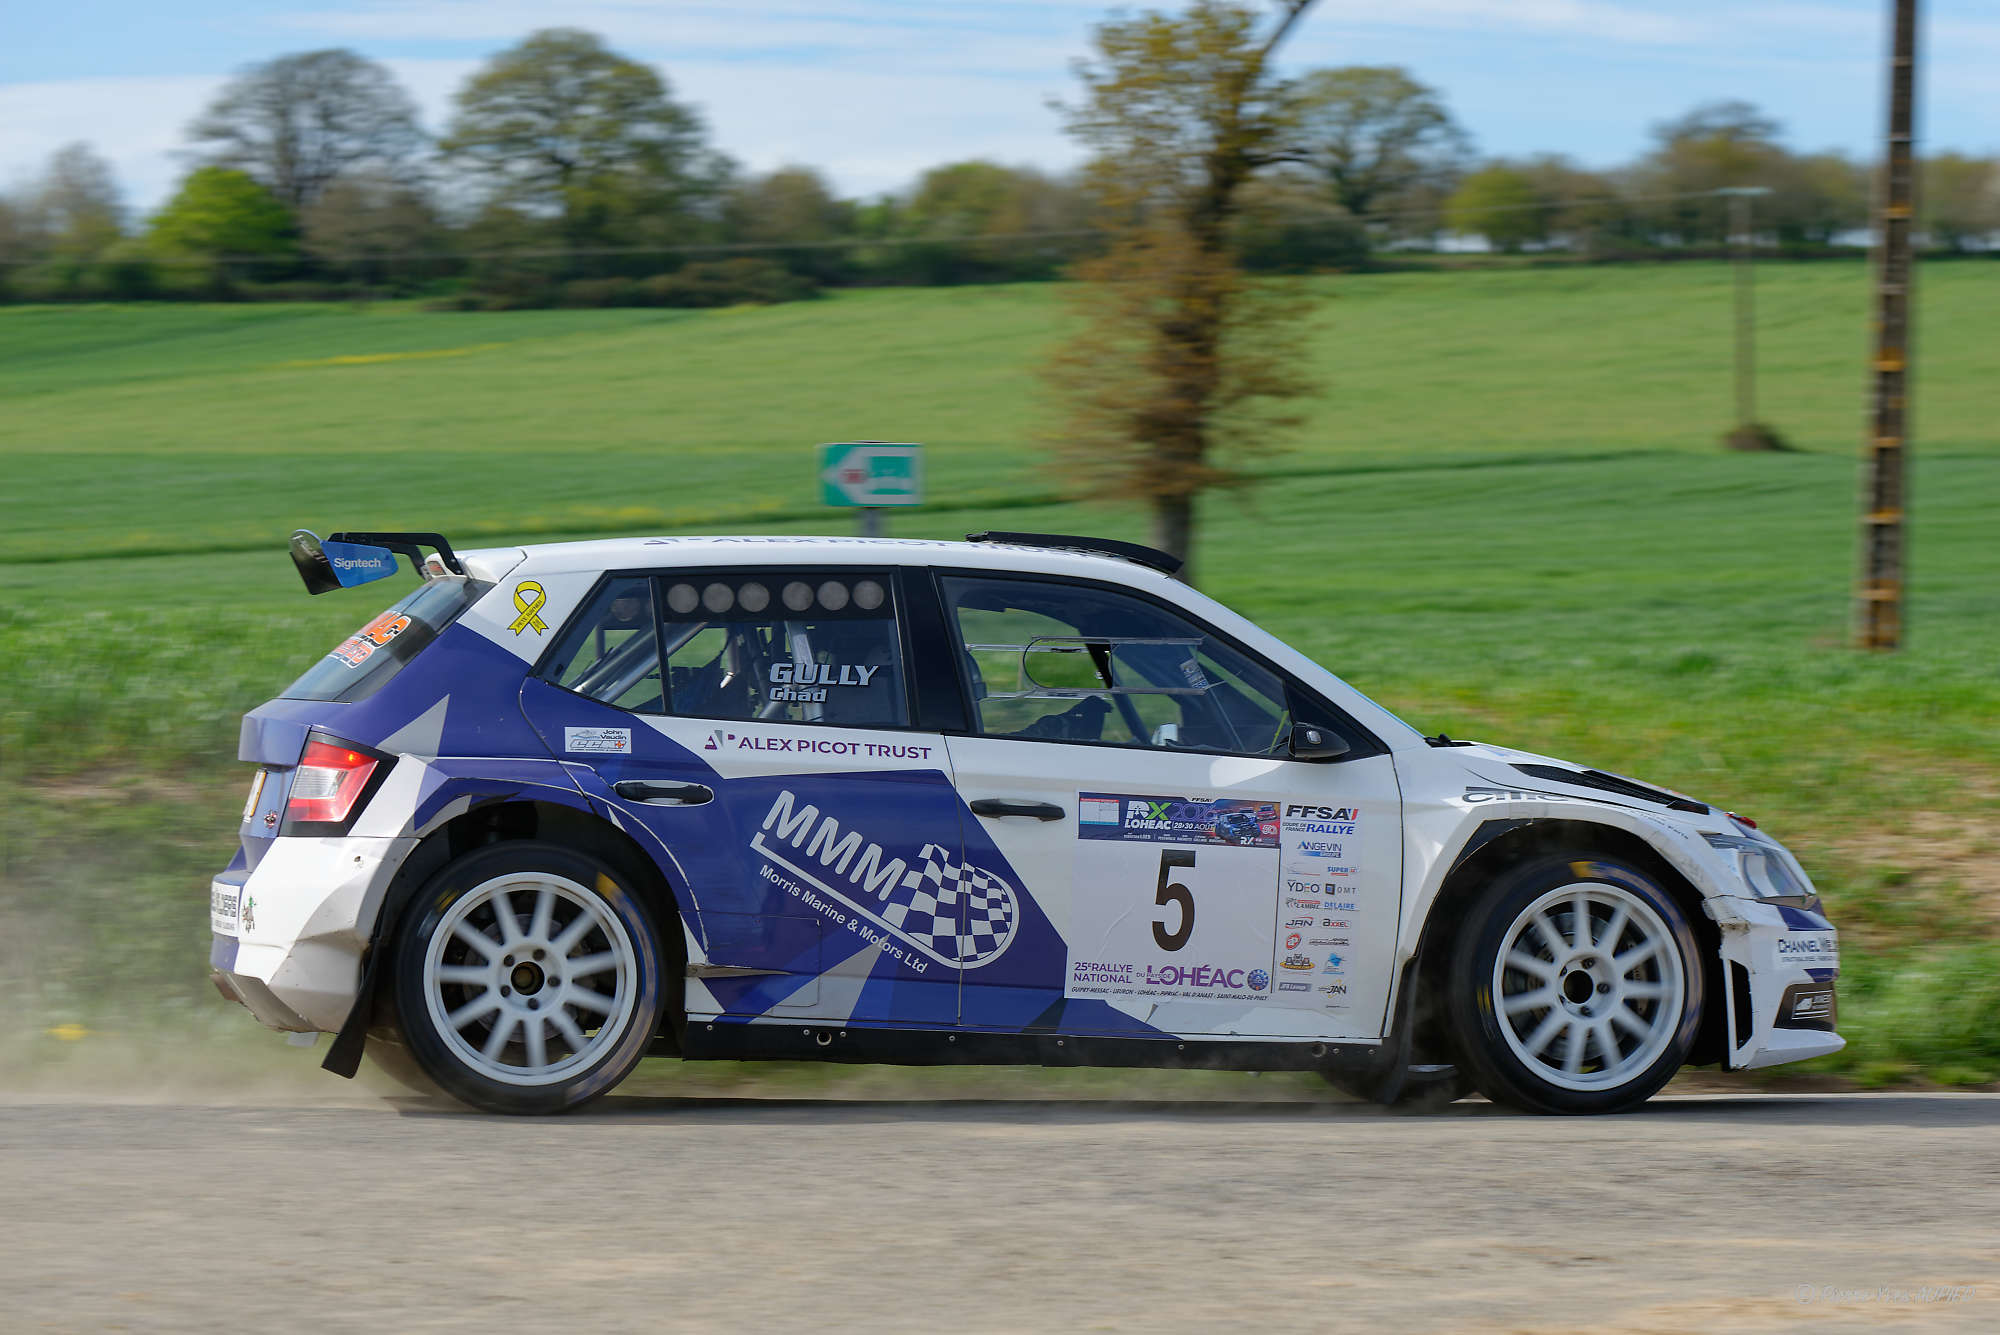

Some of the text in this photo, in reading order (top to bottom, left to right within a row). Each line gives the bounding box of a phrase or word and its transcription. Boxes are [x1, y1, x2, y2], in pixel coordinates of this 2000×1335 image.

[334, 557, 382, 570] Signtech
[769, 662, 879, 687] GULLY
[769, 687, 827, 703] Chad
[738, 736, 932, 760] ALEX PICOT TRUST
[1285, 804, 1350, 821] FFSA
[1124, 818, 1172, 830] LOHEAC
[1306, 823, 1355, 835] RALLYE
[762, 790, 906, 901] MMM
[1296, 840, 1342, 852] ANGEVIN
[1152, 849, 1196, 952] 5
[759, 864, 928, 974] Morris Marine & Motors Ltd
[1777, 938, 1820, 953] CHANNEL
[1091, 962, 1133, 973] RALLYE
[1073, 973, 1133, 984] NATIONAL
[1146, 964, 1245, 989] LOHÉAC
